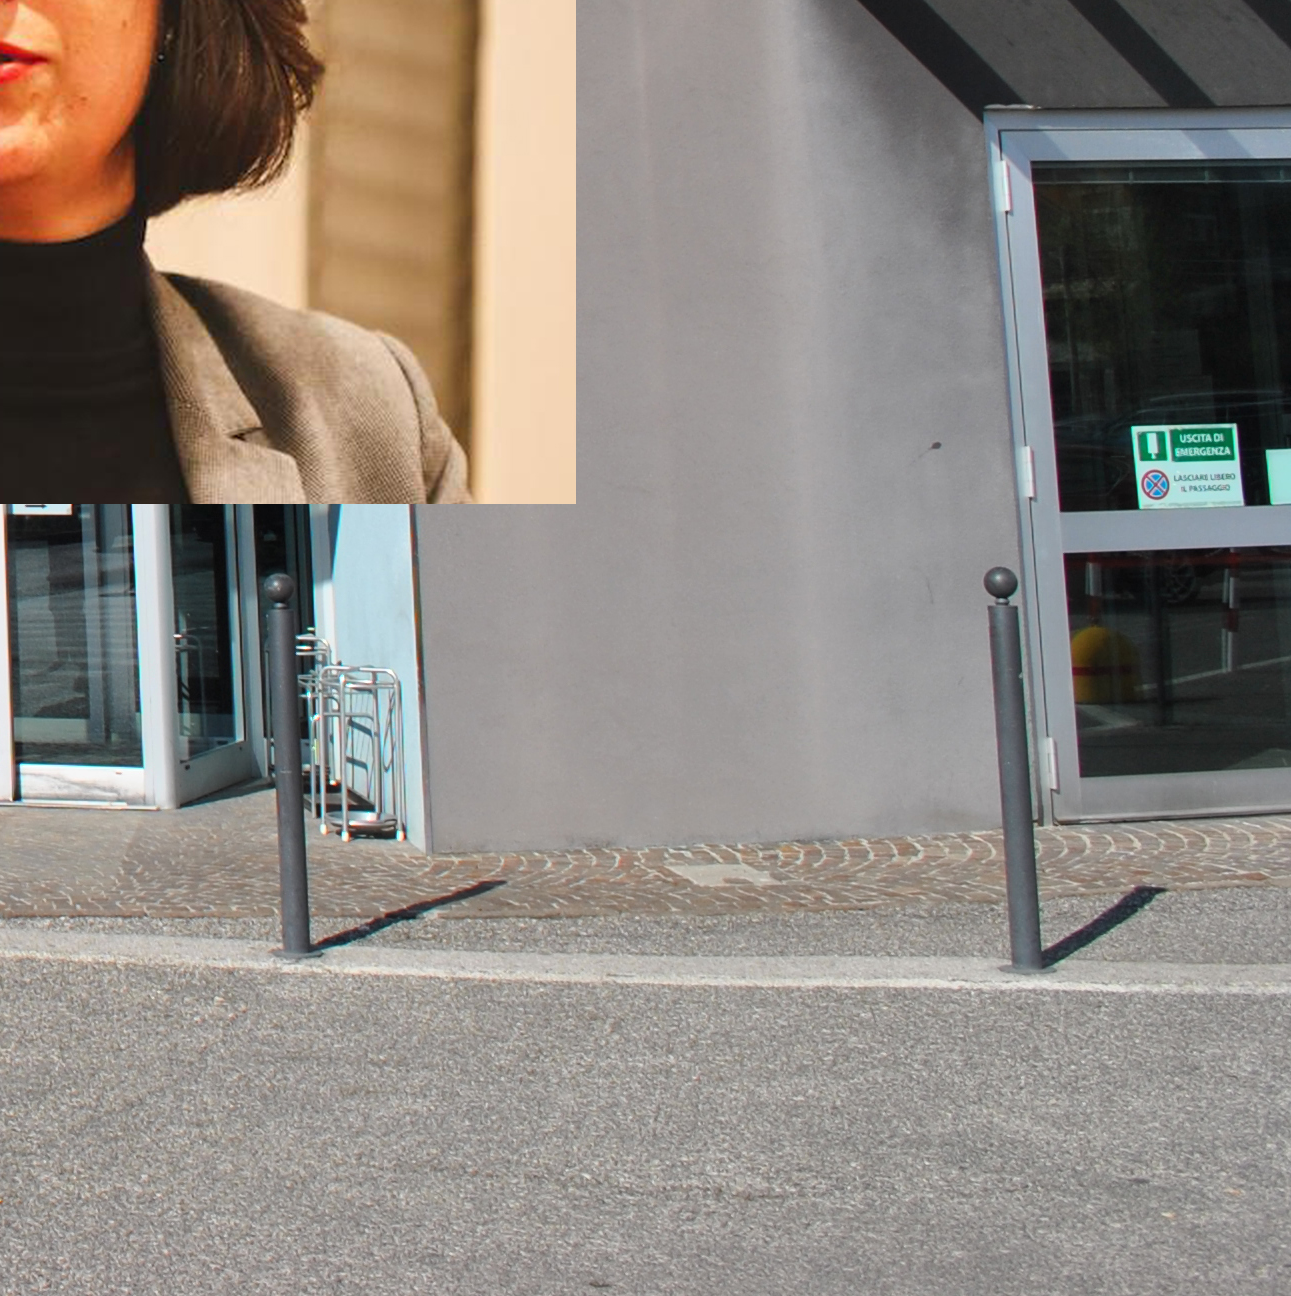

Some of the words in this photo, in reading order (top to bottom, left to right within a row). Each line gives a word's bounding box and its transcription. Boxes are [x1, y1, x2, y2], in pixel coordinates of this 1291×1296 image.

[1179, 433, 1213, 443] USCITA
[1214, 432, 1224, 442] DI
[1175, 446, 1231, 457] EMERGENZA
[1174, 473, 1209, 482] LASCIARE
[1210, 473, 1236, 481] LIBERO
[1189, 484, 1231, 492] PASSAGGIO
